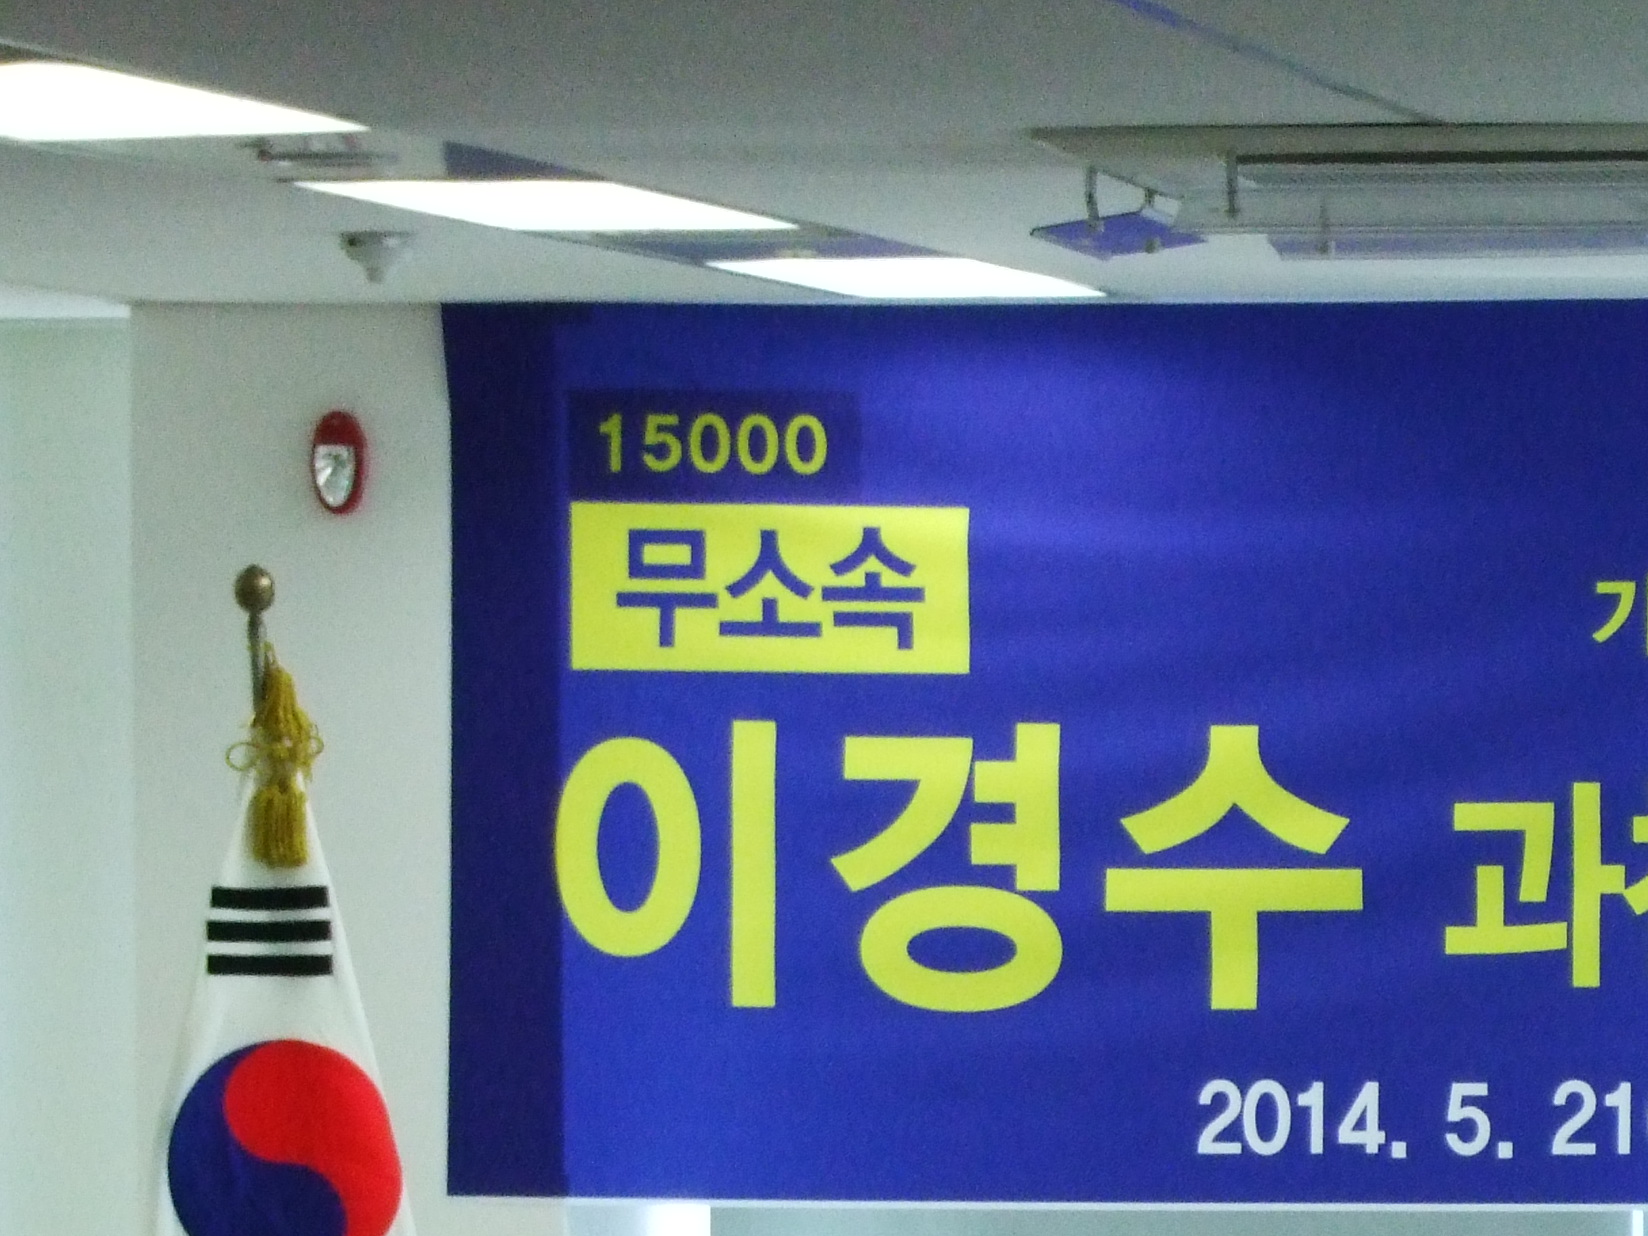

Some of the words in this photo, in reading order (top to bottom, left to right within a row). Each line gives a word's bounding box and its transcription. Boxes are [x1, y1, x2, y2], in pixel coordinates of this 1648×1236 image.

[598, 413, 829, 475] 15000
[615, 526, 926, 651] 무소속
[555, 719, 1364, 1013] 이경수
[1197, 1079, 1407, 1159] 2014.
[1444, 1082, 1514, 1160] 5.
